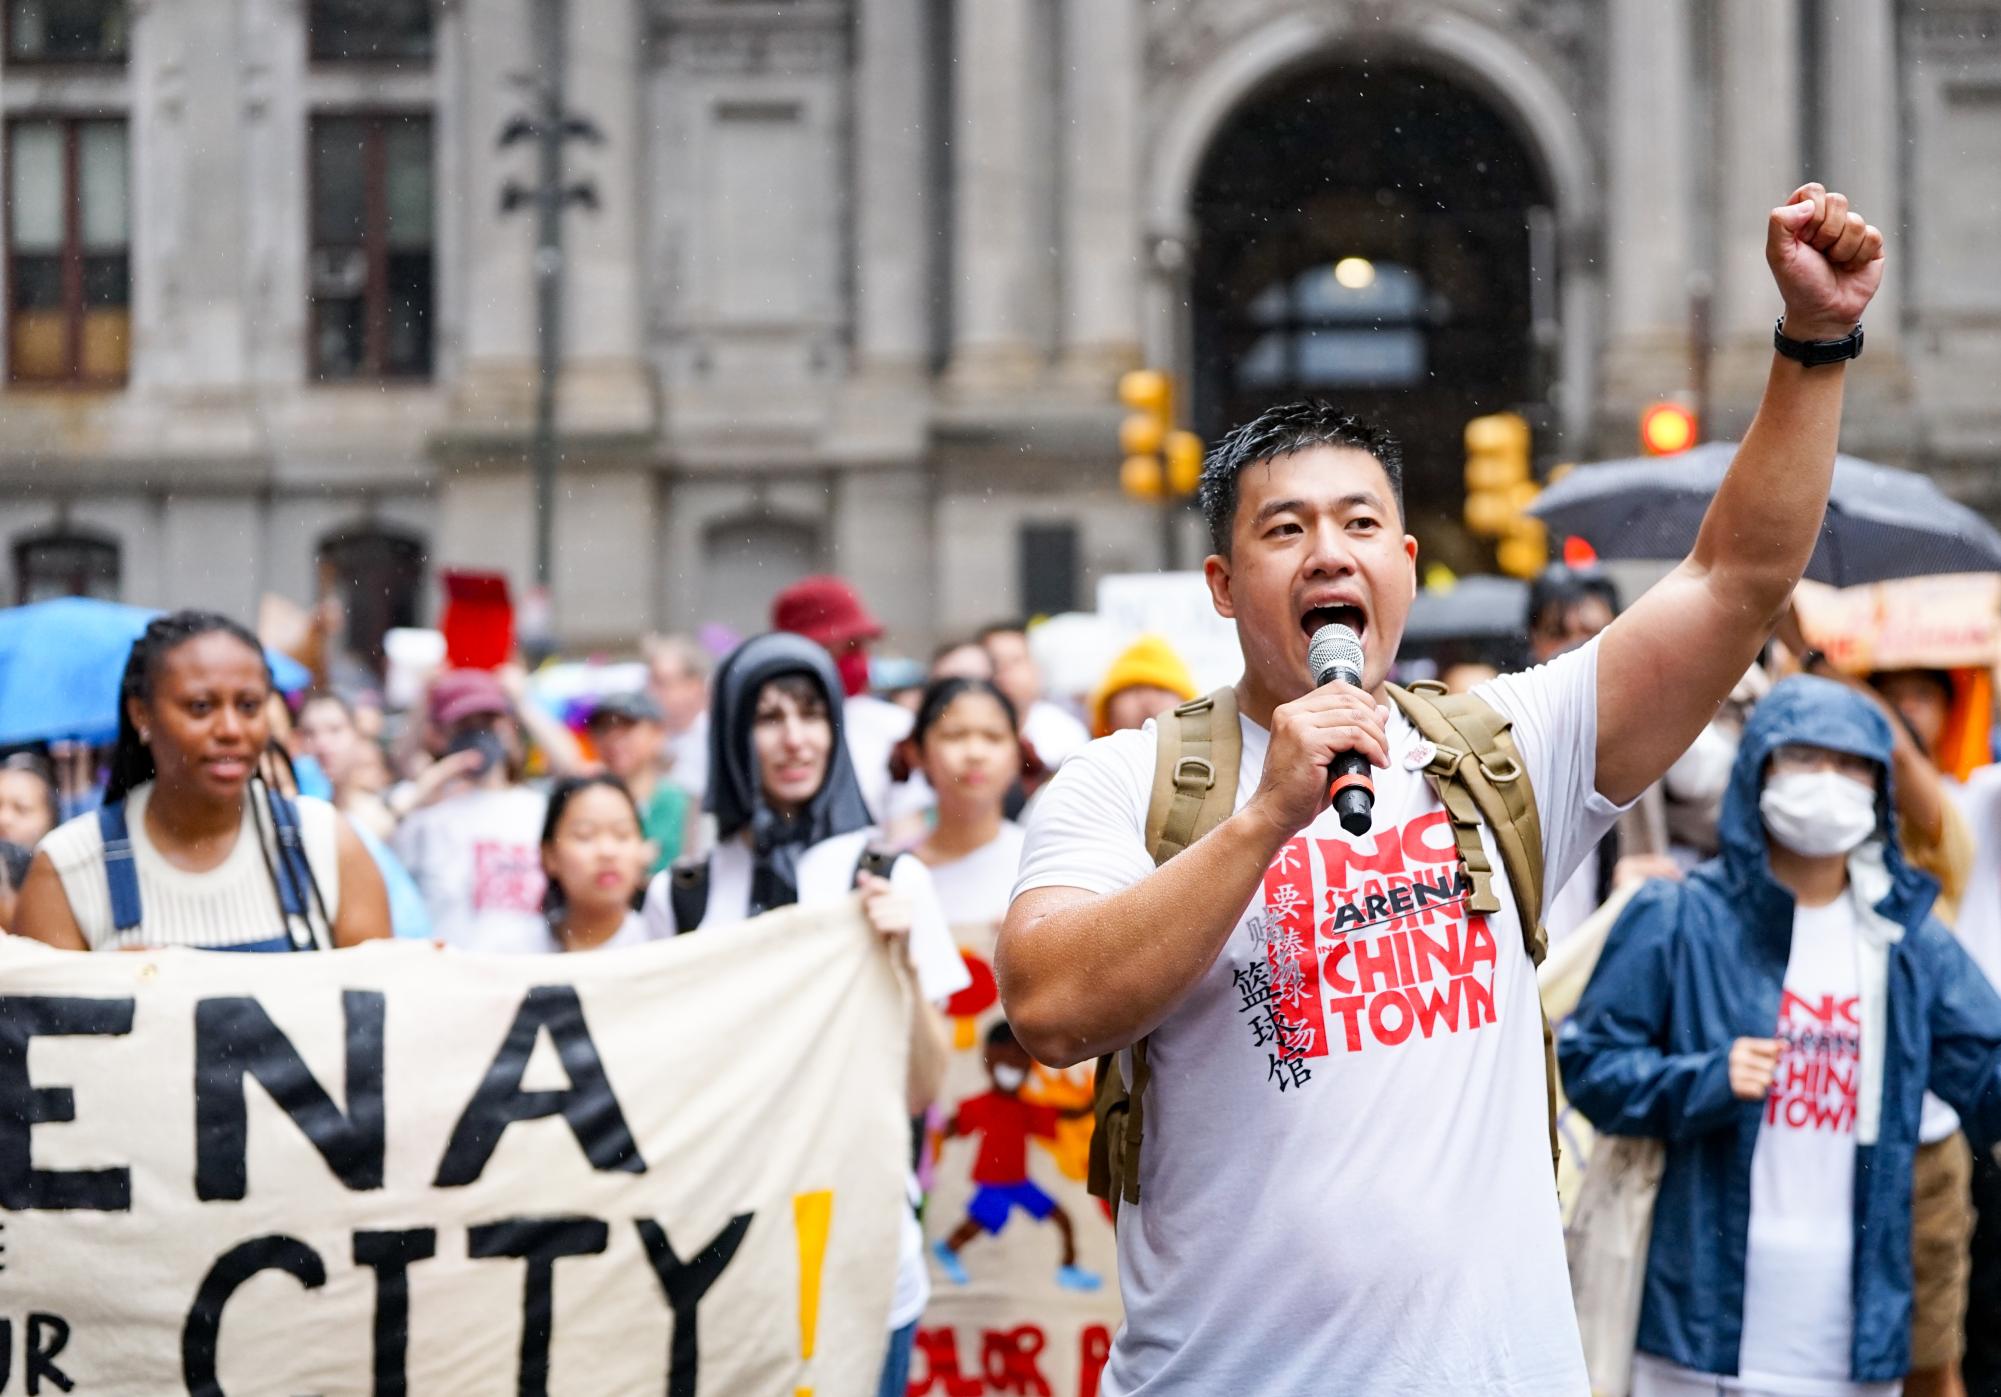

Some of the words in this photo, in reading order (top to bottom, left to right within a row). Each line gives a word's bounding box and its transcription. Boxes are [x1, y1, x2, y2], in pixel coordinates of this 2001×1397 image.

[1315, 811, 1457, 889] NO
[1323, 916, 1497, 995] CHINA
[1232, 961, 1312, 1093] 篮球馆
[1330, 974, 1497, 1053] TOWN
